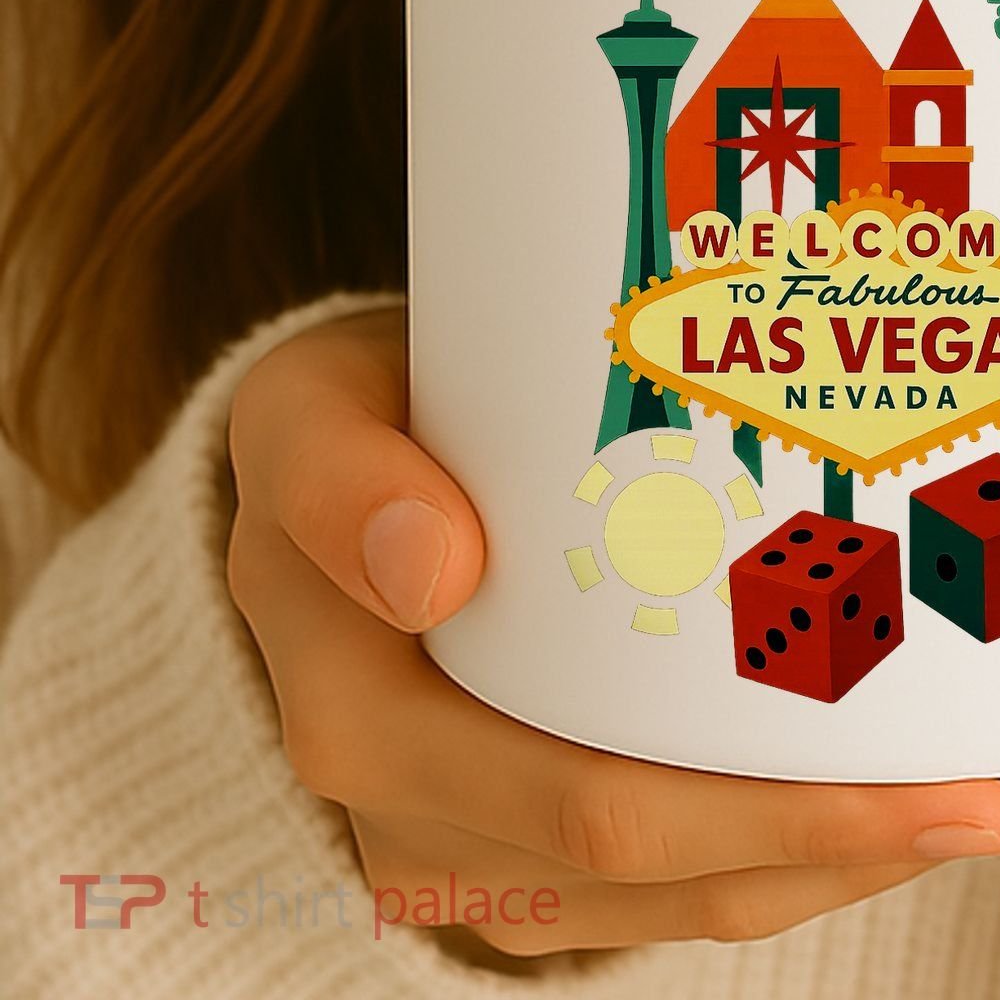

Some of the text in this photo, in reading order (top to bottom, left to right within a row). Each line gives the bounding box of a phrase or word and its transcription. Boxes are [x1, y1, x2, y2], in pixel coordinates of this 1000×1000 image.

[727, 273, 1000, 310] TO Fabulous
[681, 315, 805, 374] LAS
[785, 385, 957, 409] NEVADA
